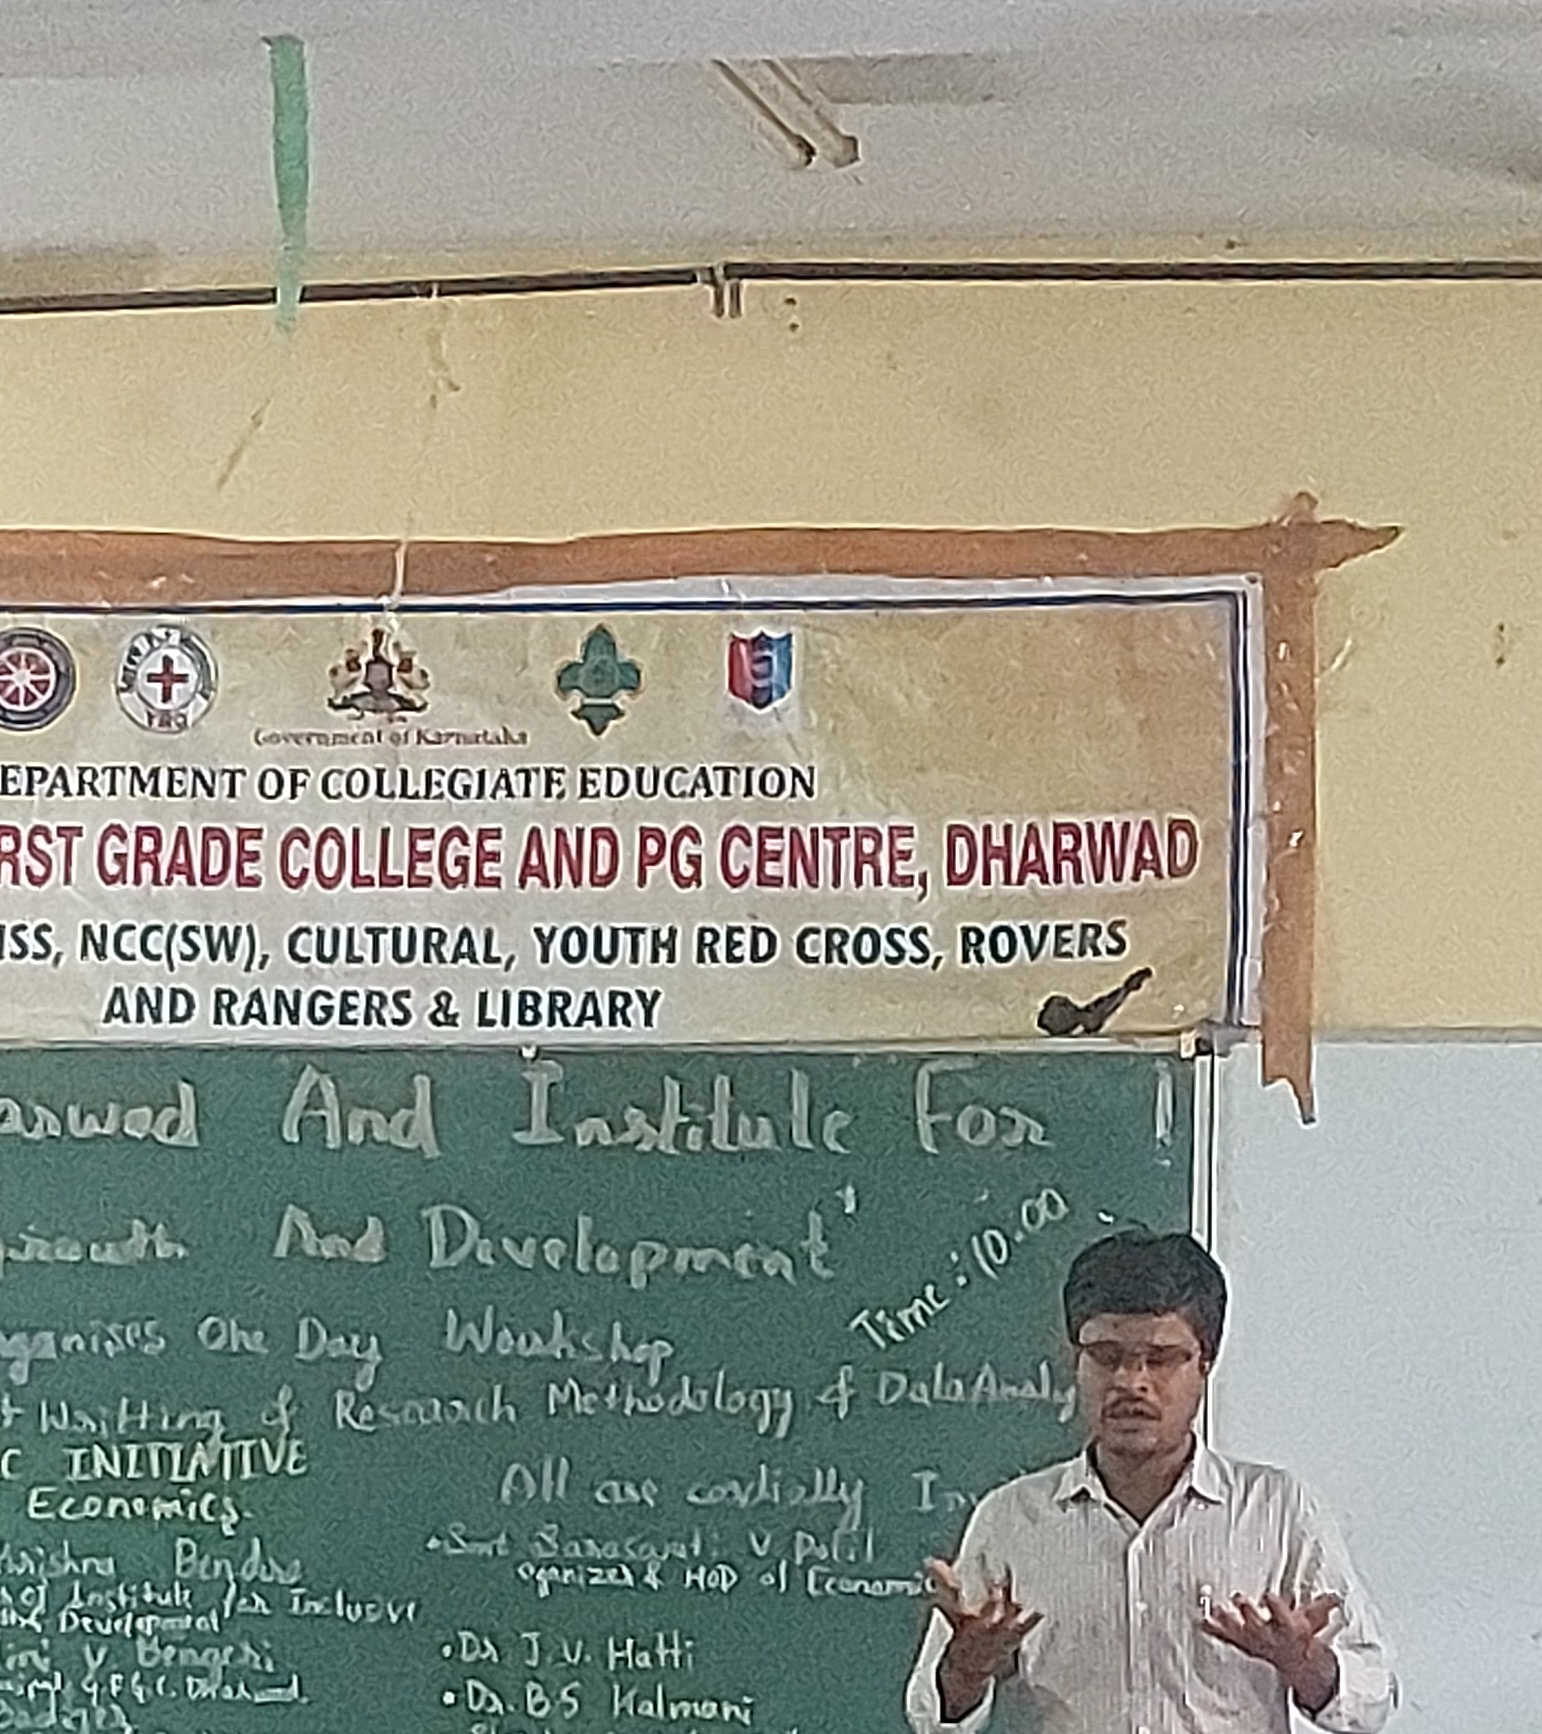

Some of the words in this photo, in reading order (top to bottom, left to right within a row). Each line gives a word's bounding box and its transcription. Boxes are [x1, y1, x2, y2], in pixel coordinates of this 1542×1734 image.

[254, 727, 383, 747] Government
[390, 728, 409, 747] of
[416, 726, 528, 746] Karnataka
[258, 767, 311, 800] OF
[320, 766, 565, 801] COLLEGIATE
[577, 765, 817, 800] EDUCATION
[96, 824, 262, 890] GRADE
[279, 824, 503, 891] COLLEGE
[517, 825, 620, 889] AND
[635, 822, 703, 889] PG
[719, 821, 931, 902] CENTRE,
[945, 817, 1201, 888] DHARWAD
[79, 922, 272, 971] NCC(SW),
[286, 926, 516, 971] CULTURAL,
[533, 926, 678, 966] YOUTH
[696, 925, 777, 965] RED
[795, 924, 944, 970] CROSS,
[959, 919, 1129, 964] ROVERS
[103, 985, 196, 1027] AND
[212, 986, 412, 1028] RANGERS
[428, 988, 459, 1028] &
[476, 988, 664, 1030] LIBRARY
[281, 1064, 443, 1159] And
[915, 1058, 1055, 1154] For
[273, 1205, 387, 1264] And
[425, 1203, 837, 1287] Development
[196, 1314, 270, 1354] One
[294, 1316, 383, 1393] Day
[445, 1305, 675, 1387] Workshop
[334, 1383, 519, 1432] Research
[547, 1370, 793, 1439] Methodology
[63, 1437, 309, 1484] INITIATIVE
[500, 1455, 569, 1504] All
[594, 1477, 660, 1507] are
[685, 1563, 739, 1594] HOD
[609, 1628, 694, 1671] Hatti
